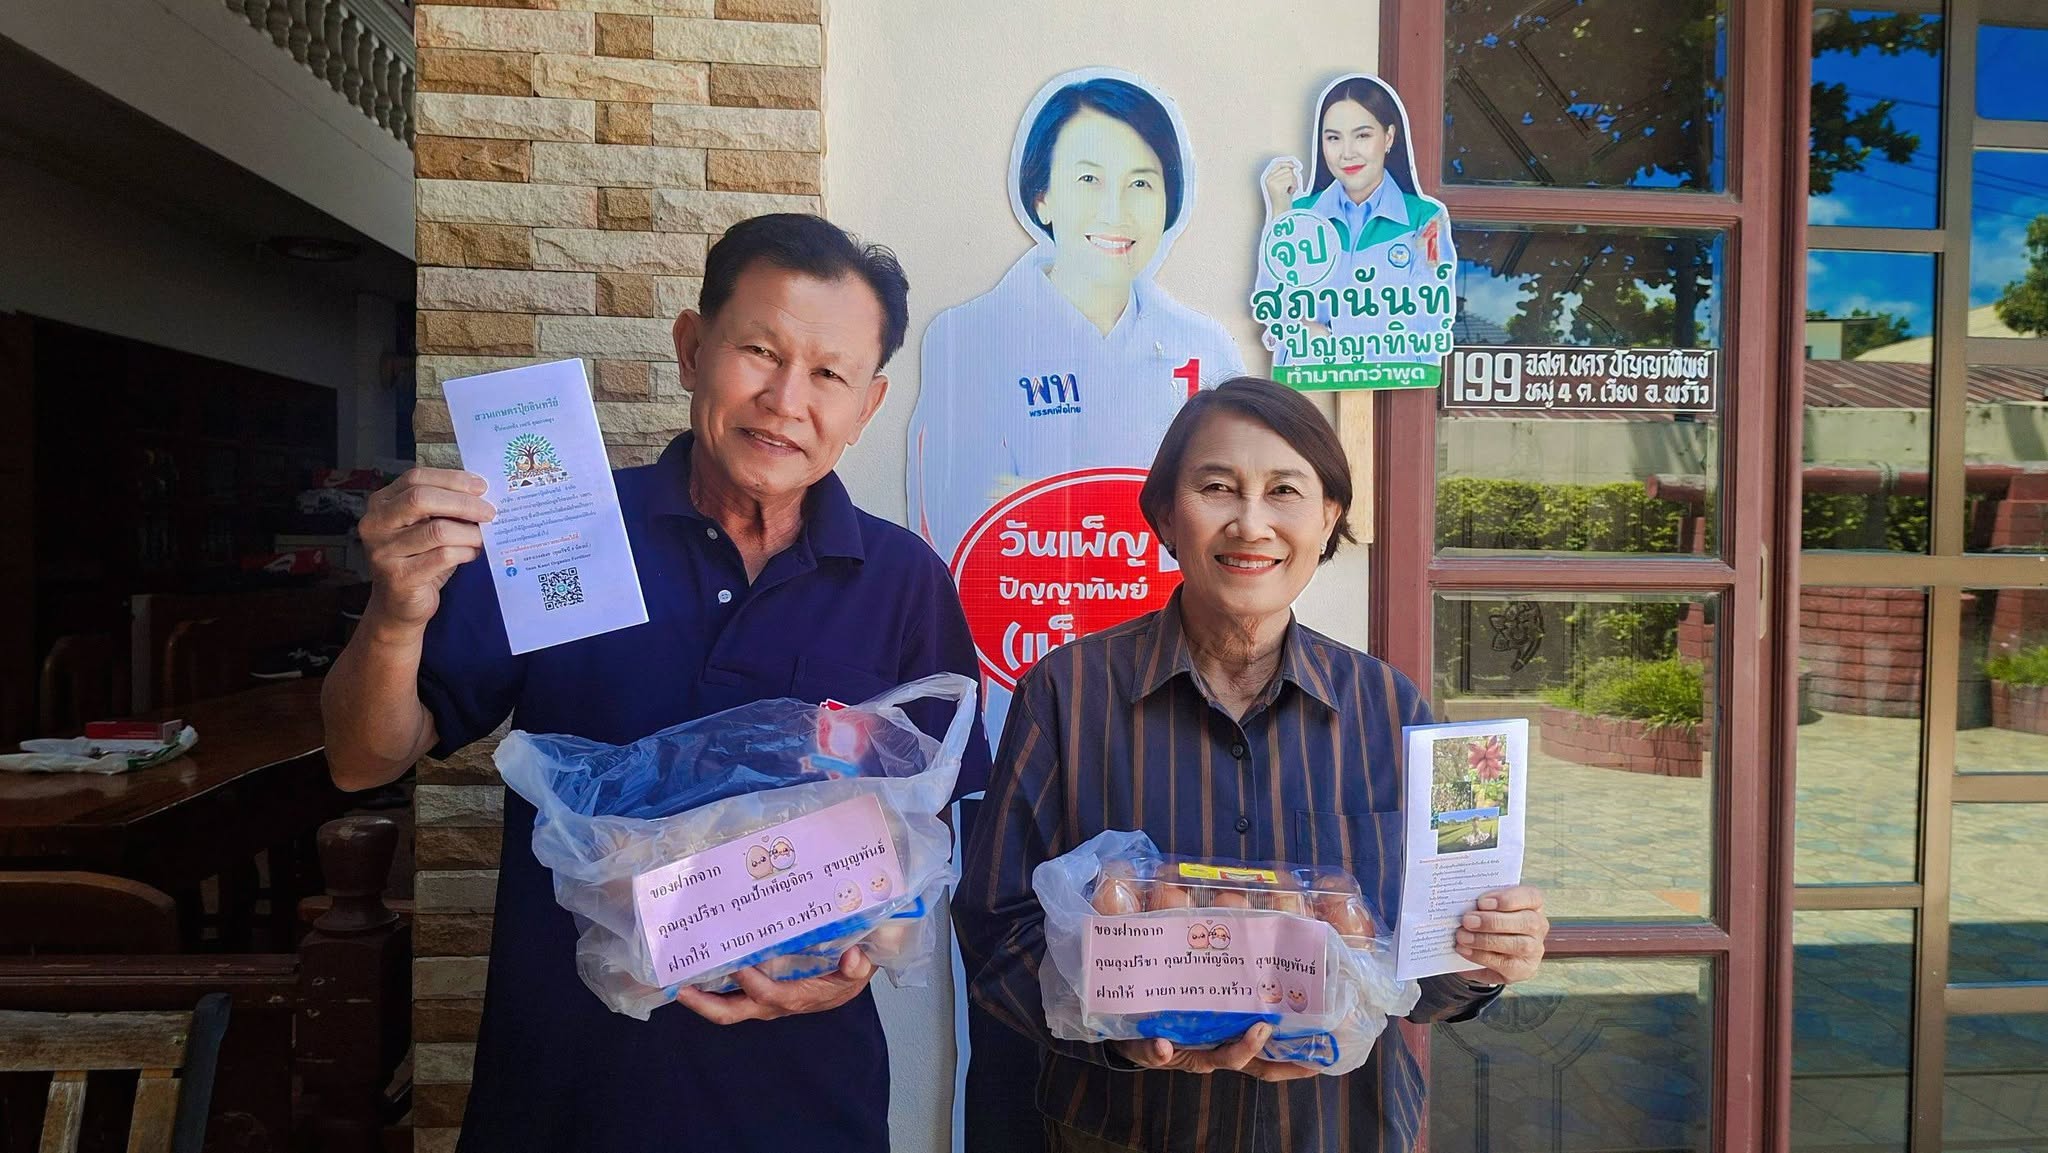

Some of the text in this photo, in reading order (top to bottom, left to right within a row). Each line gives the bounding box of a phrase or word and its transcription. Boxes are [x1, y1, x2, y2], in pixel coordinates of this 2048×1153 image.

[1271, 218, 1328, 286] จุ๊ป
[1252, 264, 1454, 341] สุภานันท์
[1286, 318, 1454, 364] ปัญญาทิพย์
[1286, 364, 1426, 386] ทำมากกว่าพูด
[1453, 351, 1522, 402] 199
[1608, 349, 1712, 379] ปัญญาทิพย์
[1525, 380, 1554, 408] หมู่
[1558, 384, 1572, 400] 4
[1600, 379, 1638, 403] เวียง
[1028, 403, 1082, 418] พรรคเพื่อไทย
[999, 515, 1149, 567] วันเพ็ญ
[999, 576, 1149, 606] ปัญญาทิพย์
[650, 865, 722, 899] ของฝากจาก
[658, 838, 886, 939] คุณลุงปรีชา คุณป้าเพ็ญจิตร สุขบุญพันธ์
[1094, 922, 1164, 937] ของฝากจาก
[668, 941, 711, 973] ฝากให้
[720, 931, 755, 952] นายก
[757, 919, 784, 939] นคร
[1095, 954, 1158, 972] คุณลุงปรีชา
[1164, 951, 1245, 969] คุณป้าเพ็ญจิตร
[1096, 984, 1135, 999] ฝากให้
[1145, 985, 1176, 997] นายก
[1180, 985, 1205, 996] นคร
